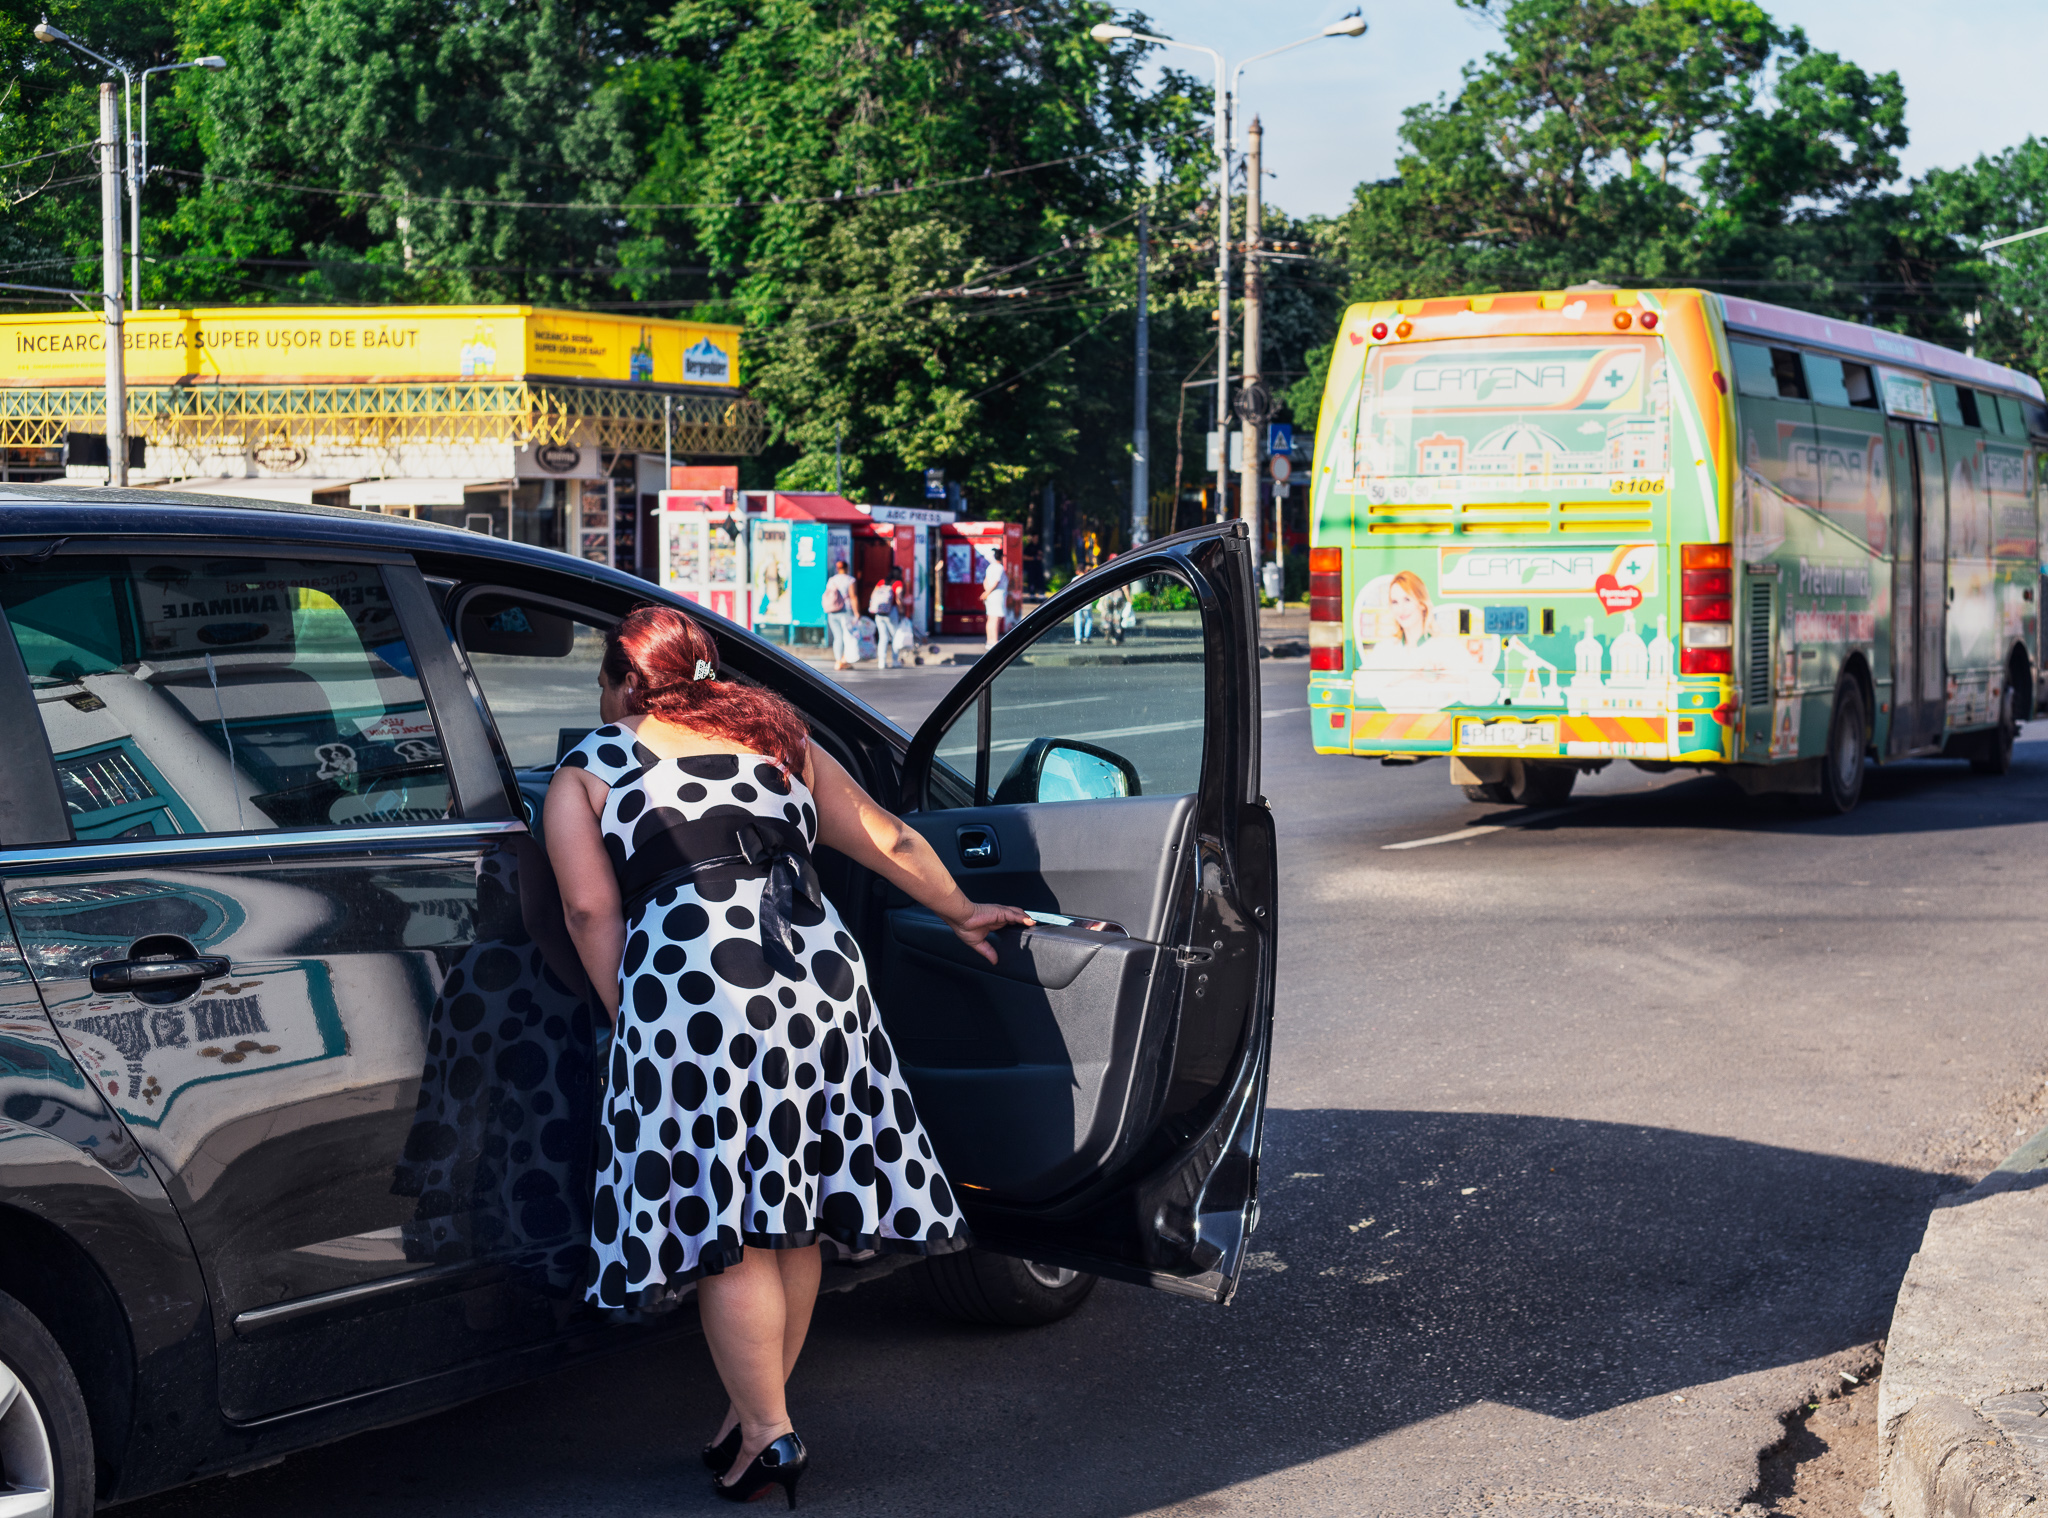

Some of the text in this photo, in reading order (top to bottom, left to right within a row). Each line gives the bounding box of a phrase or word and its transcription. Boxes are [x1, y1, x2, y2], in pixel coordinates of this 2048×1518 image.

[124, 332, 188, 349] BEREA
[194, 331, 259, 349] SUPER
[267, 331, 321, 356] UȘOR
[330, 331, 355, 347] DE
[364, 324, 419, 347] BĂUT
[1414, 366, 1565, 393] CATENA
[1610, 480, 1665, 495] 3106
[886, 510, 942, 522] ABC PRESS
[1468, 557, 1594, 578] CATENA
